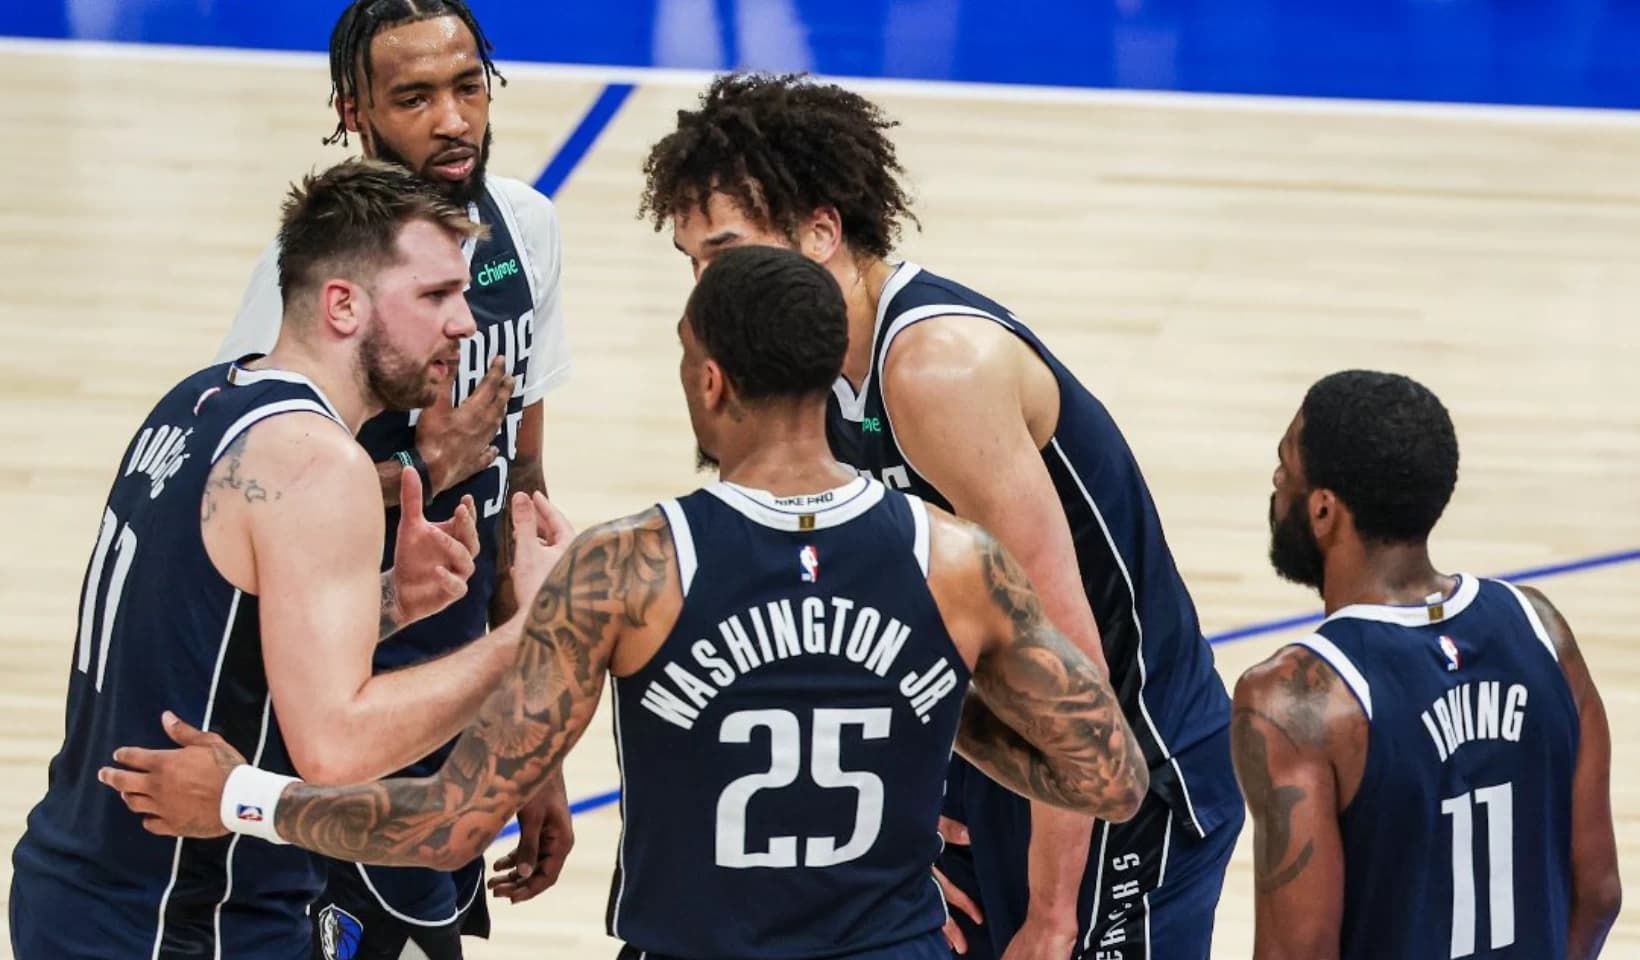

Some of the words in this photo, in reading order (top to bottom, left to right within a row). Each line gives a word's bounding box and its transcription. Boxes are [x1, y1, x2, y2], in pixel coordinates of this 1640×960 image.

[477, 257, 519, 287] chime
[807, 491, 834, 506] PRO
[640, 596, 912, 730] WASHINGTON
[899, 656, 958, 725] JR.
[1421, 681, 1528, 763] IRVING
[715, 707, 893, 869] 25
[1440, 781, 1515, 960] 11
